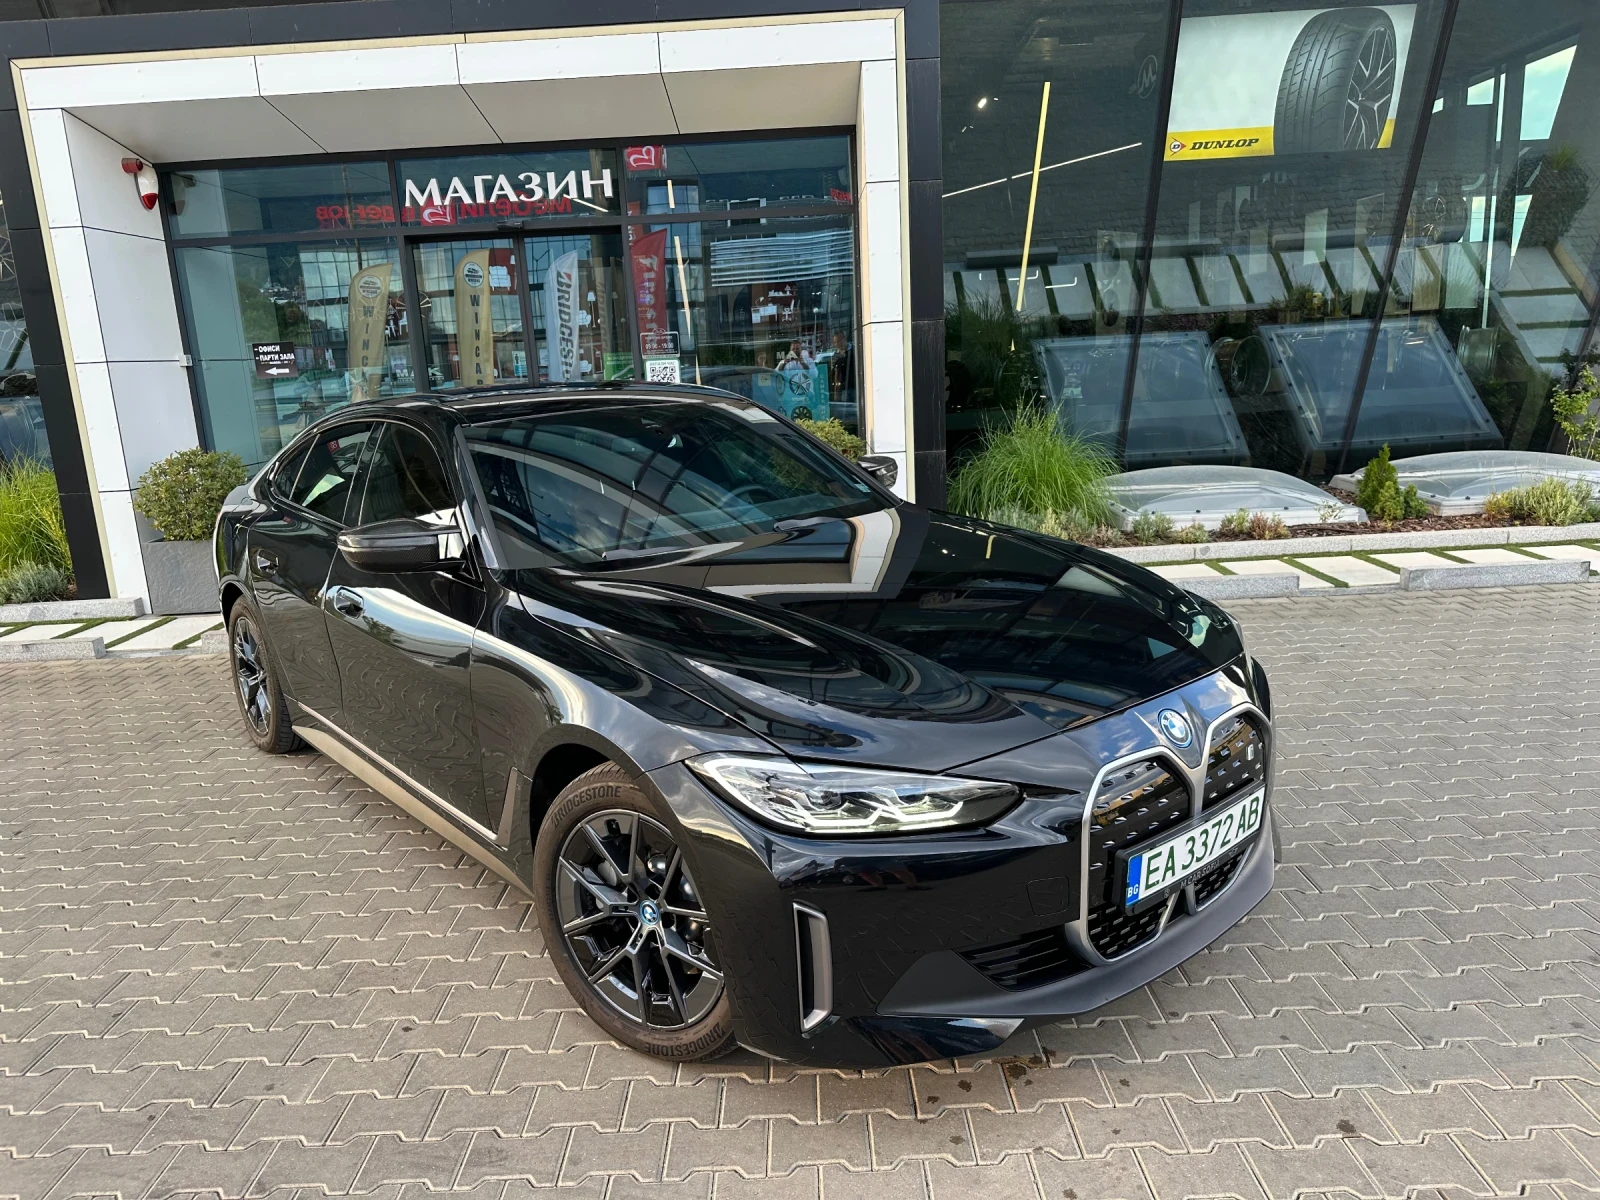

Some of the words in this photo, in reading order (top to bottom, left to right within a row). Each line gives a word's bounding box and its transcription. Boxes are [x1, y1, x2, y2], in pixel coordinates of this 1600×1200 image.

[1189, 138, 1260, 151] DUNLOP
[404, 168, 614, 207] МАГАЗИН
[776, 350, 799, 360] MA
[550, 785, 622, 830] BRIDGESTONE
[1126, 884, 1139, 898] BG
[1144, 845, 1176, 891] EA
[1181, 813, 1234, 870] 3372
[1235, 796, 1260, 839] AB
[644, 1021, 726, 1057] BRIDGESTONE
